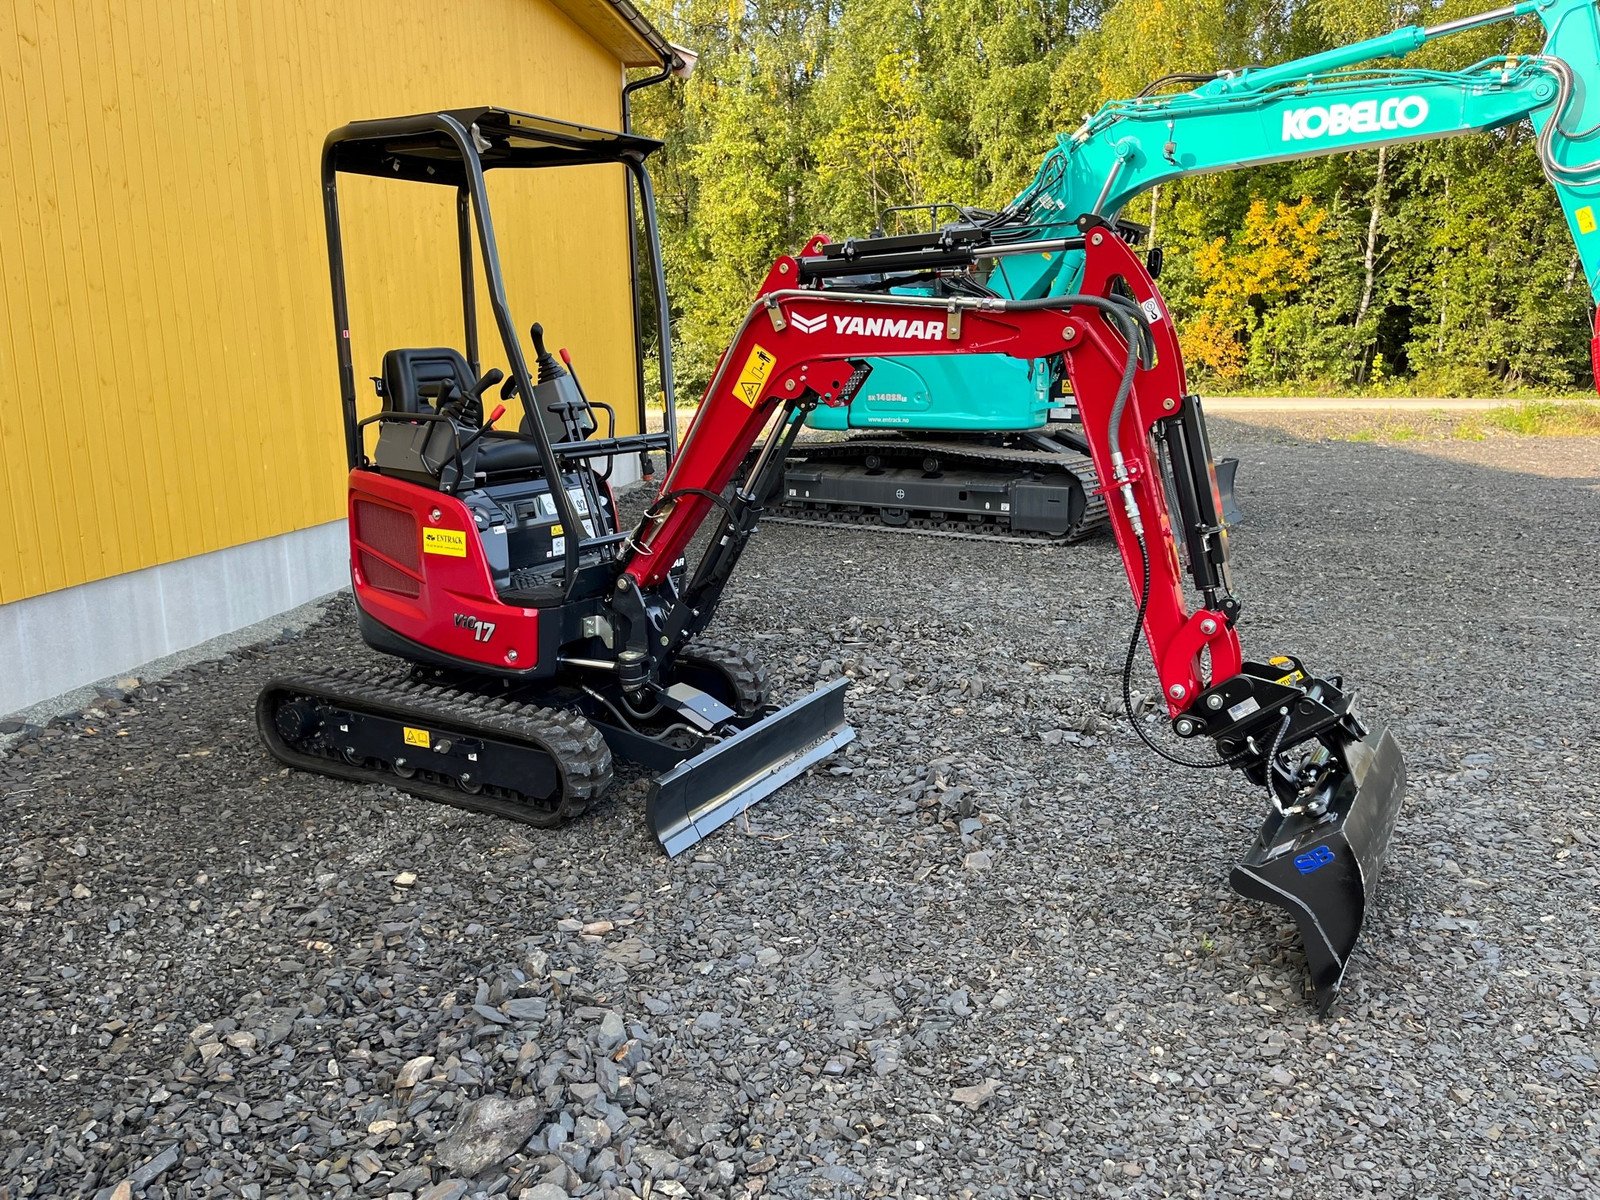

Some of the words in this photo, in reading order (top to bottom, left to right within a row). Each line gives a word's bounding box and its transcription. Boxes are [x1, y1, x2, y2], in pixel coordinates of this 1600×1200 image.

[1282, 95, 1429, 142] KOBELCO
[833, 315, 944, 340] YANMAR
[436, 534, 463, 545] ENTRACK
